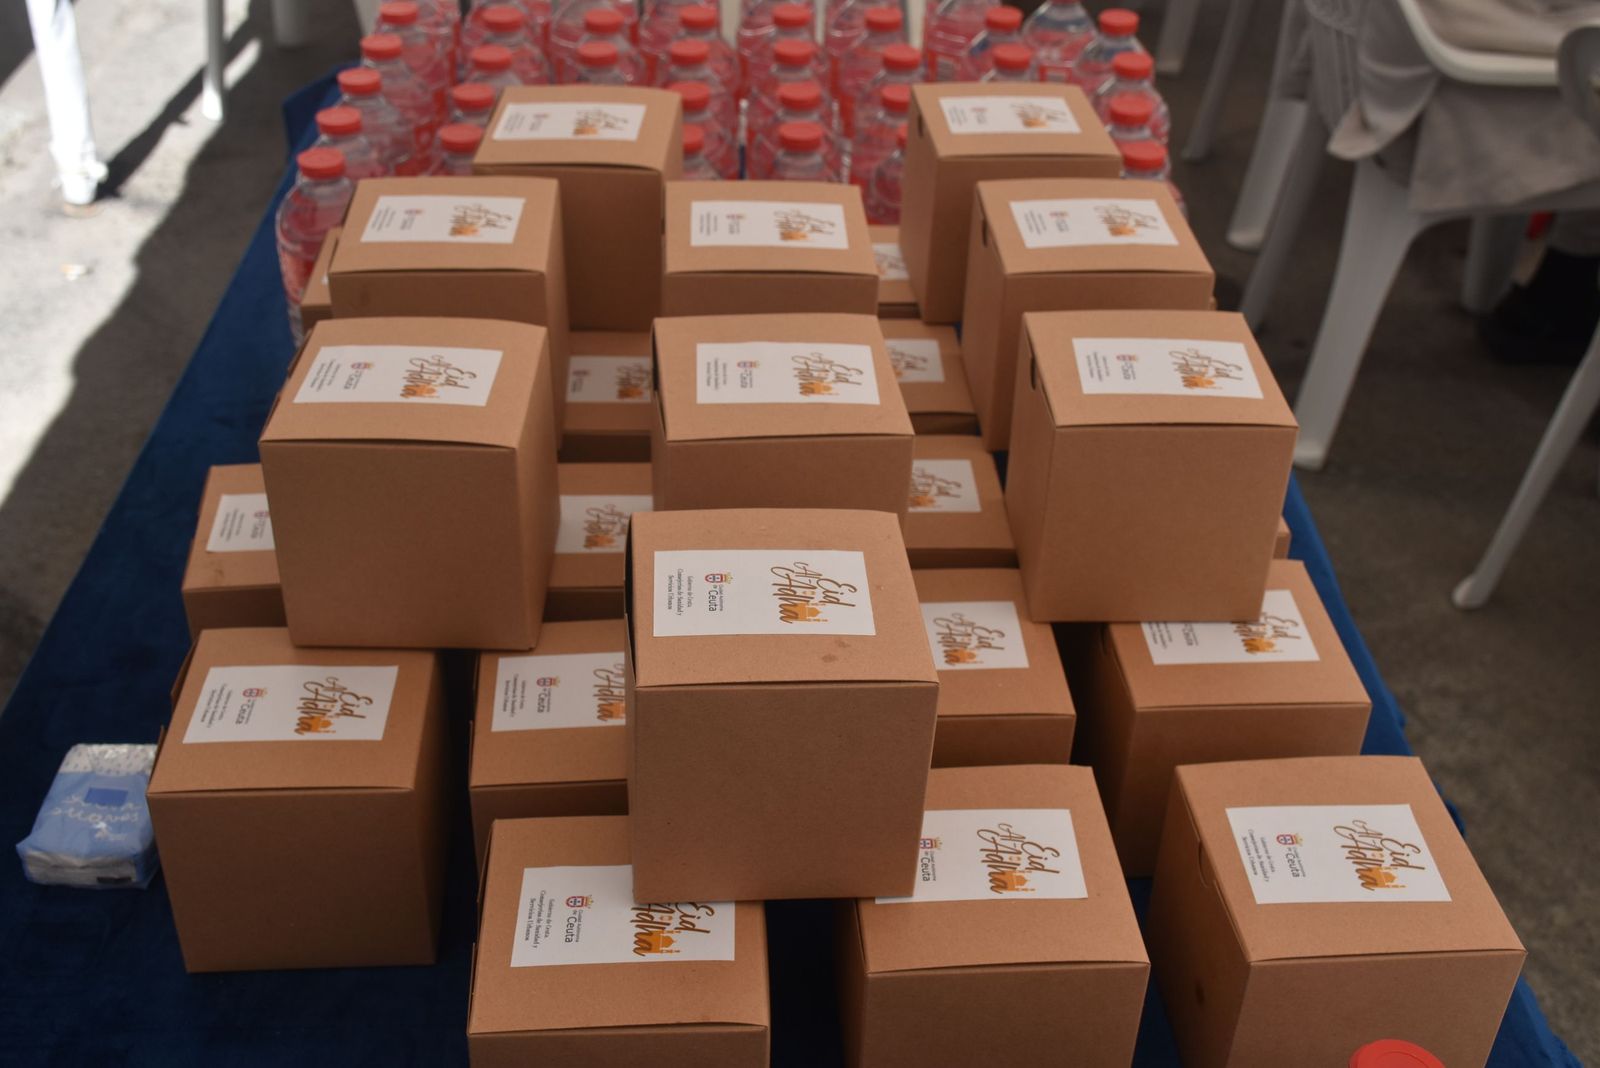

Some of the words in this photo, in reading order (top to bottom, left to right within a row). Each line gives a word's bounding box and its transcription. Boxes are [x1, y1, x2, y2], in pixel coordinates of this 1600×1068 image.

[442, 367, 477, 389] Eid
[830, 363, 864, 385] Eid
[708, 590, 718, 611] Ceuta
[771, 566, 818, 624] Adha
[817, 578, 857, 607] Eid
[971, 626, 1005, 650] Eid
[1264, 615, 1302, 639] Eid
[933, 618, 972, 666] Adha
[294, 681, 338, 735] Adha
[336, 692, 373, 719] Eid
[976, 828, 1023, 894] Adha
[1020, 841, 1060, 874] Eid
[1284, 853, 1302, 877] Ceuta
[1333, 825, 1385, 891] Adha
[1380, 838, 1425, 870] Eid
[920, 857, 931, 882] Ceuta
[564, 916, 576, 942] Ceuta
[674, 902, 715, 934] Eid
